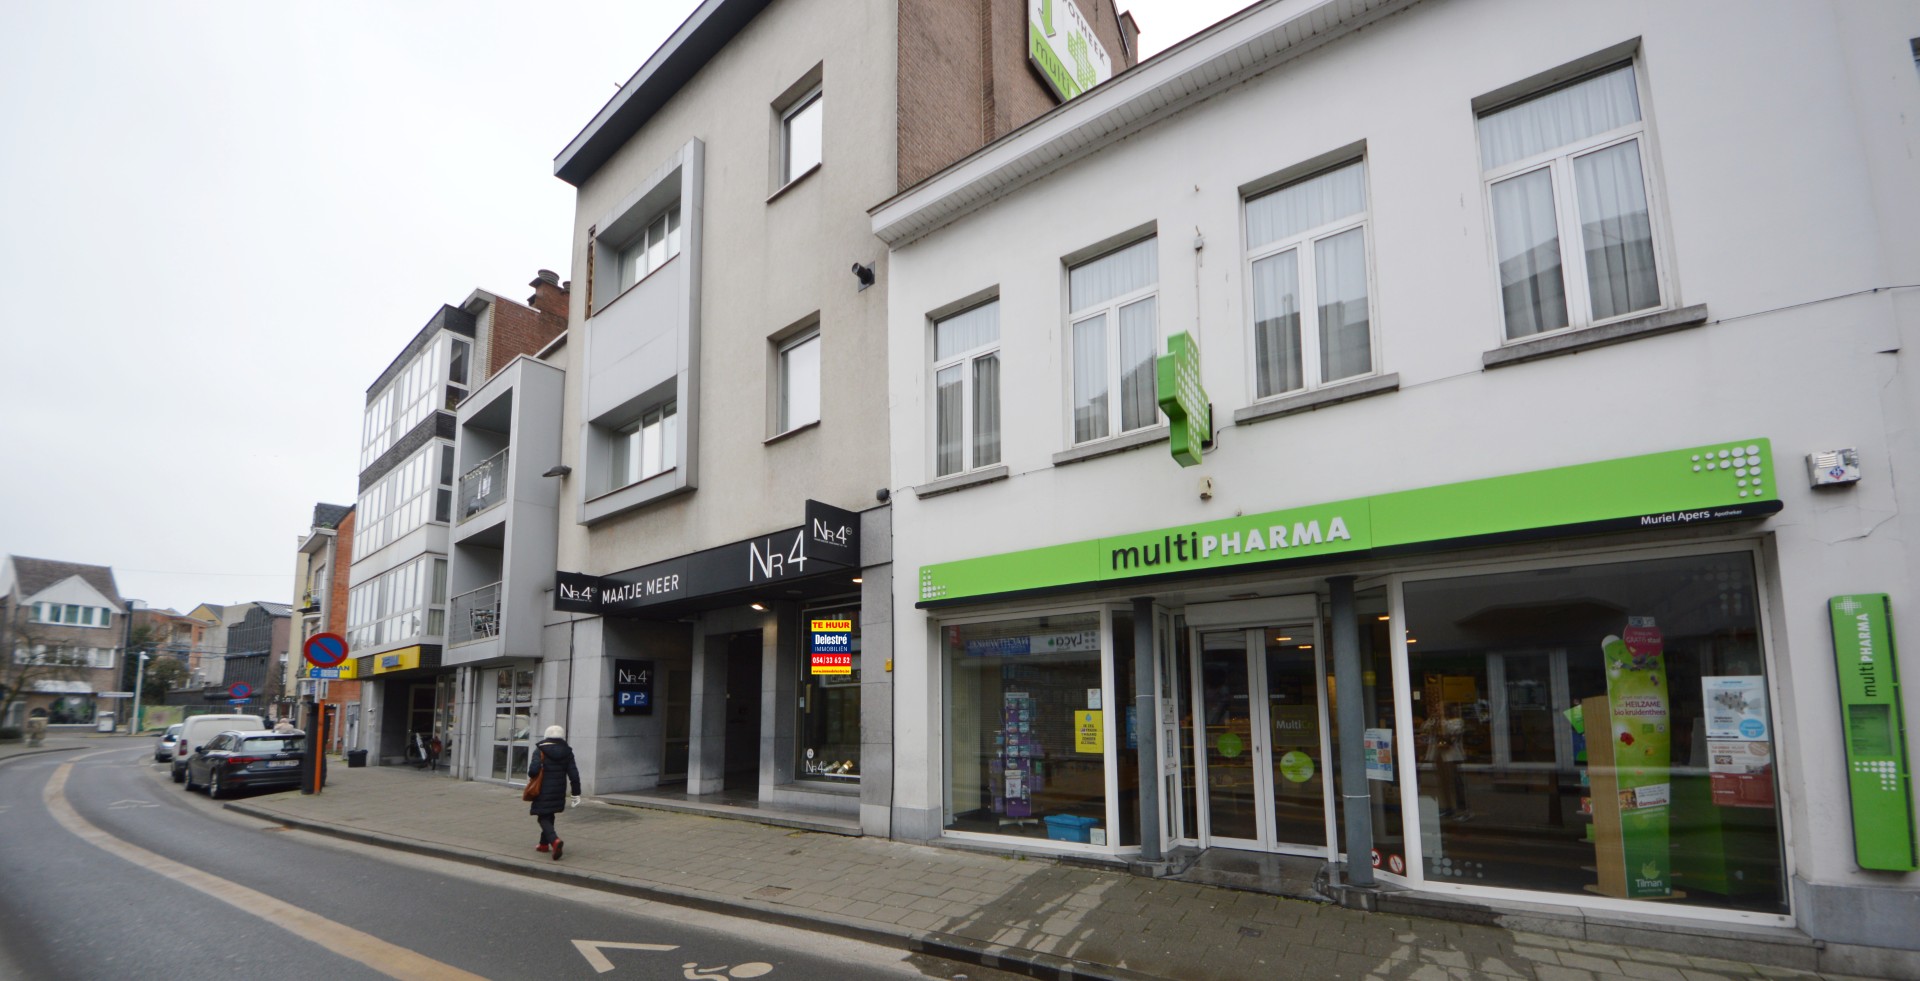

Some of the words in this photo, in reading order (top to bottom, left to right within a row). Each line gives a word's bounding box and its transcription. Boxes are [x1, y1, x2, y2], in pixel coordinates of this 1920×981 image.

[1063, 0, 1105, 65] OTHEEK
[1641, 513, 1675, 525] Muriel
[1678, 510, 1710, 521] Apers
[835, 525, 847, 544] 4
[787, 529, 808, 572] 4
[581, 586, 592, 600] 4
[602, 582, 642, 605] MAATJE
[646, 574, 679, 596] MEER
[621, 692, 631, 704] P
